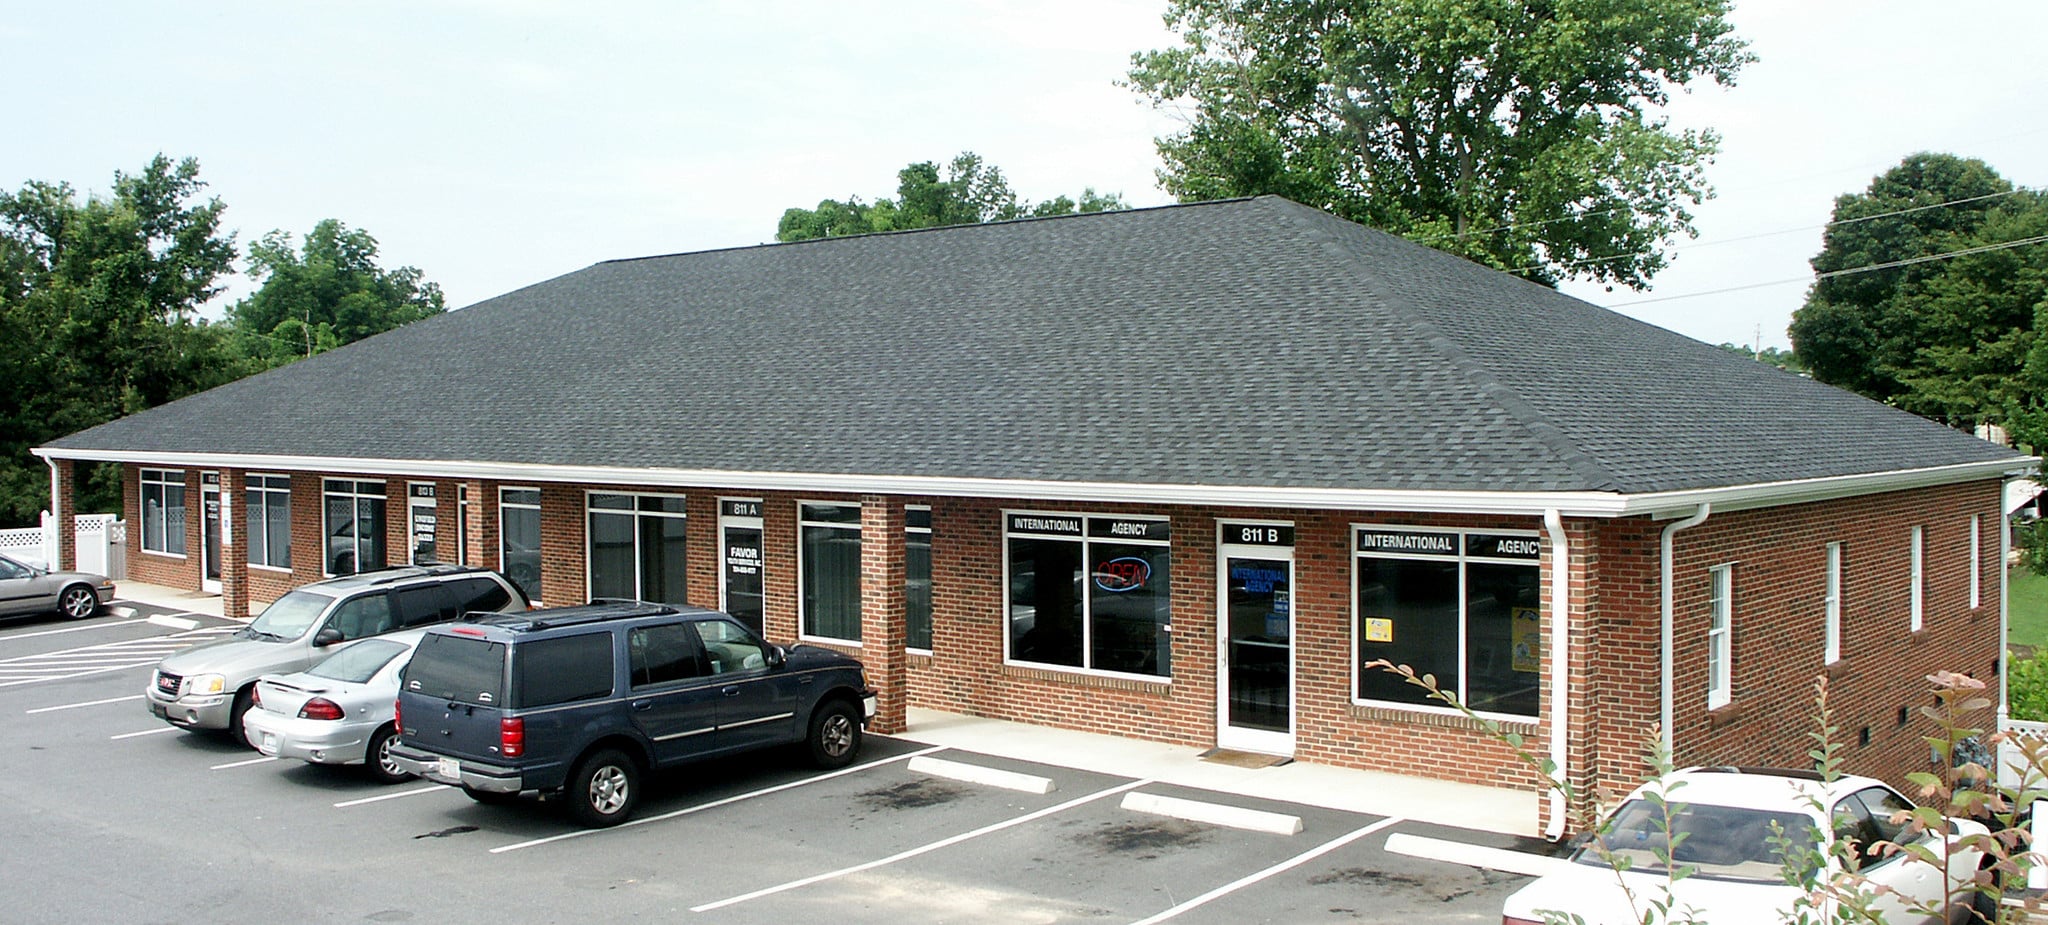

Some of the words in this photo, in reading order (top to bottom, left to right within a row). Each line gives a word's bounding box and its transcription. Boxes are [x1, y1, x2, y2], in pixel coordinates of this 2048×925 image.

[733, 503, 747, 515] 811
[749, 504, 757, 516] A
[1014, 517, 1080, 532] INTERNATIONAL
[1111, 522, 1147, 535] AGENCY
[1241, 527, 1262, 542] 811
[1268, 528, 1278, 542] B
[1364, 534, 1452, 550] INTERNATIONAL
[730, 547, 758, 559] FAVOR
[1097, 561, 1147, 587] OPEN
[1231, 568, 1285, 582] INTERNATIONAL
